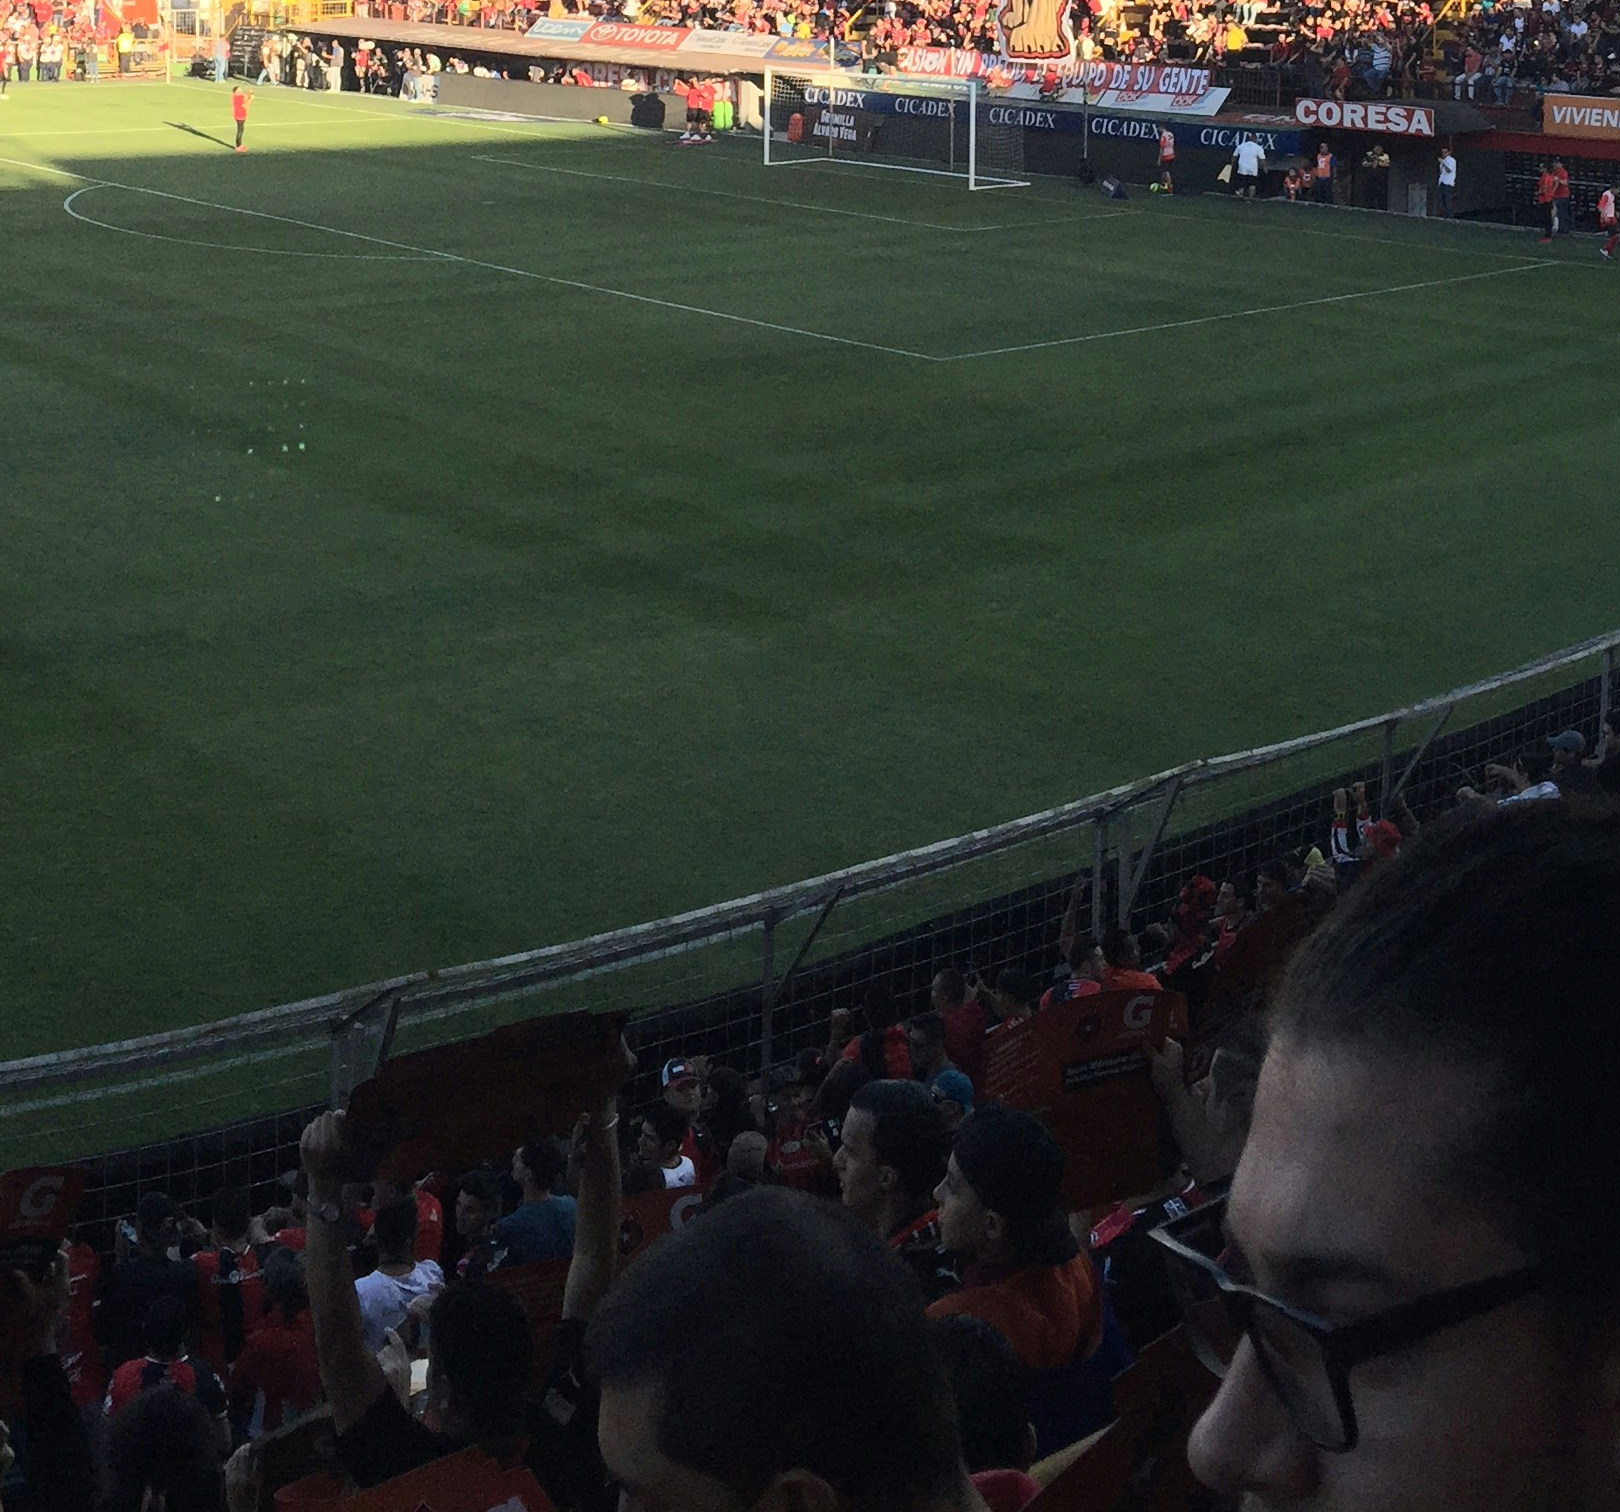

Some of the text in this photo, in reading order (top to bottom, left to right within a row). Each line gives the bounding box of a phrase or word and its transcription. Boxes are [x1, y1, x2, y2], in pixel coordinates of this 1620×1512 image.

[618, 26, 678, 46] TOYOTA
[1112, 62, 1210, 95] DE SU GENTE
[804, 87, 866, 108] CICADEX
[894, 97, 956, 118] CICADEX
[989, 107, 1057, 129] CICADEX
[1295, 99, 1431, 136] CORESA
[1091, 118, 1161, 140] CICADEX
